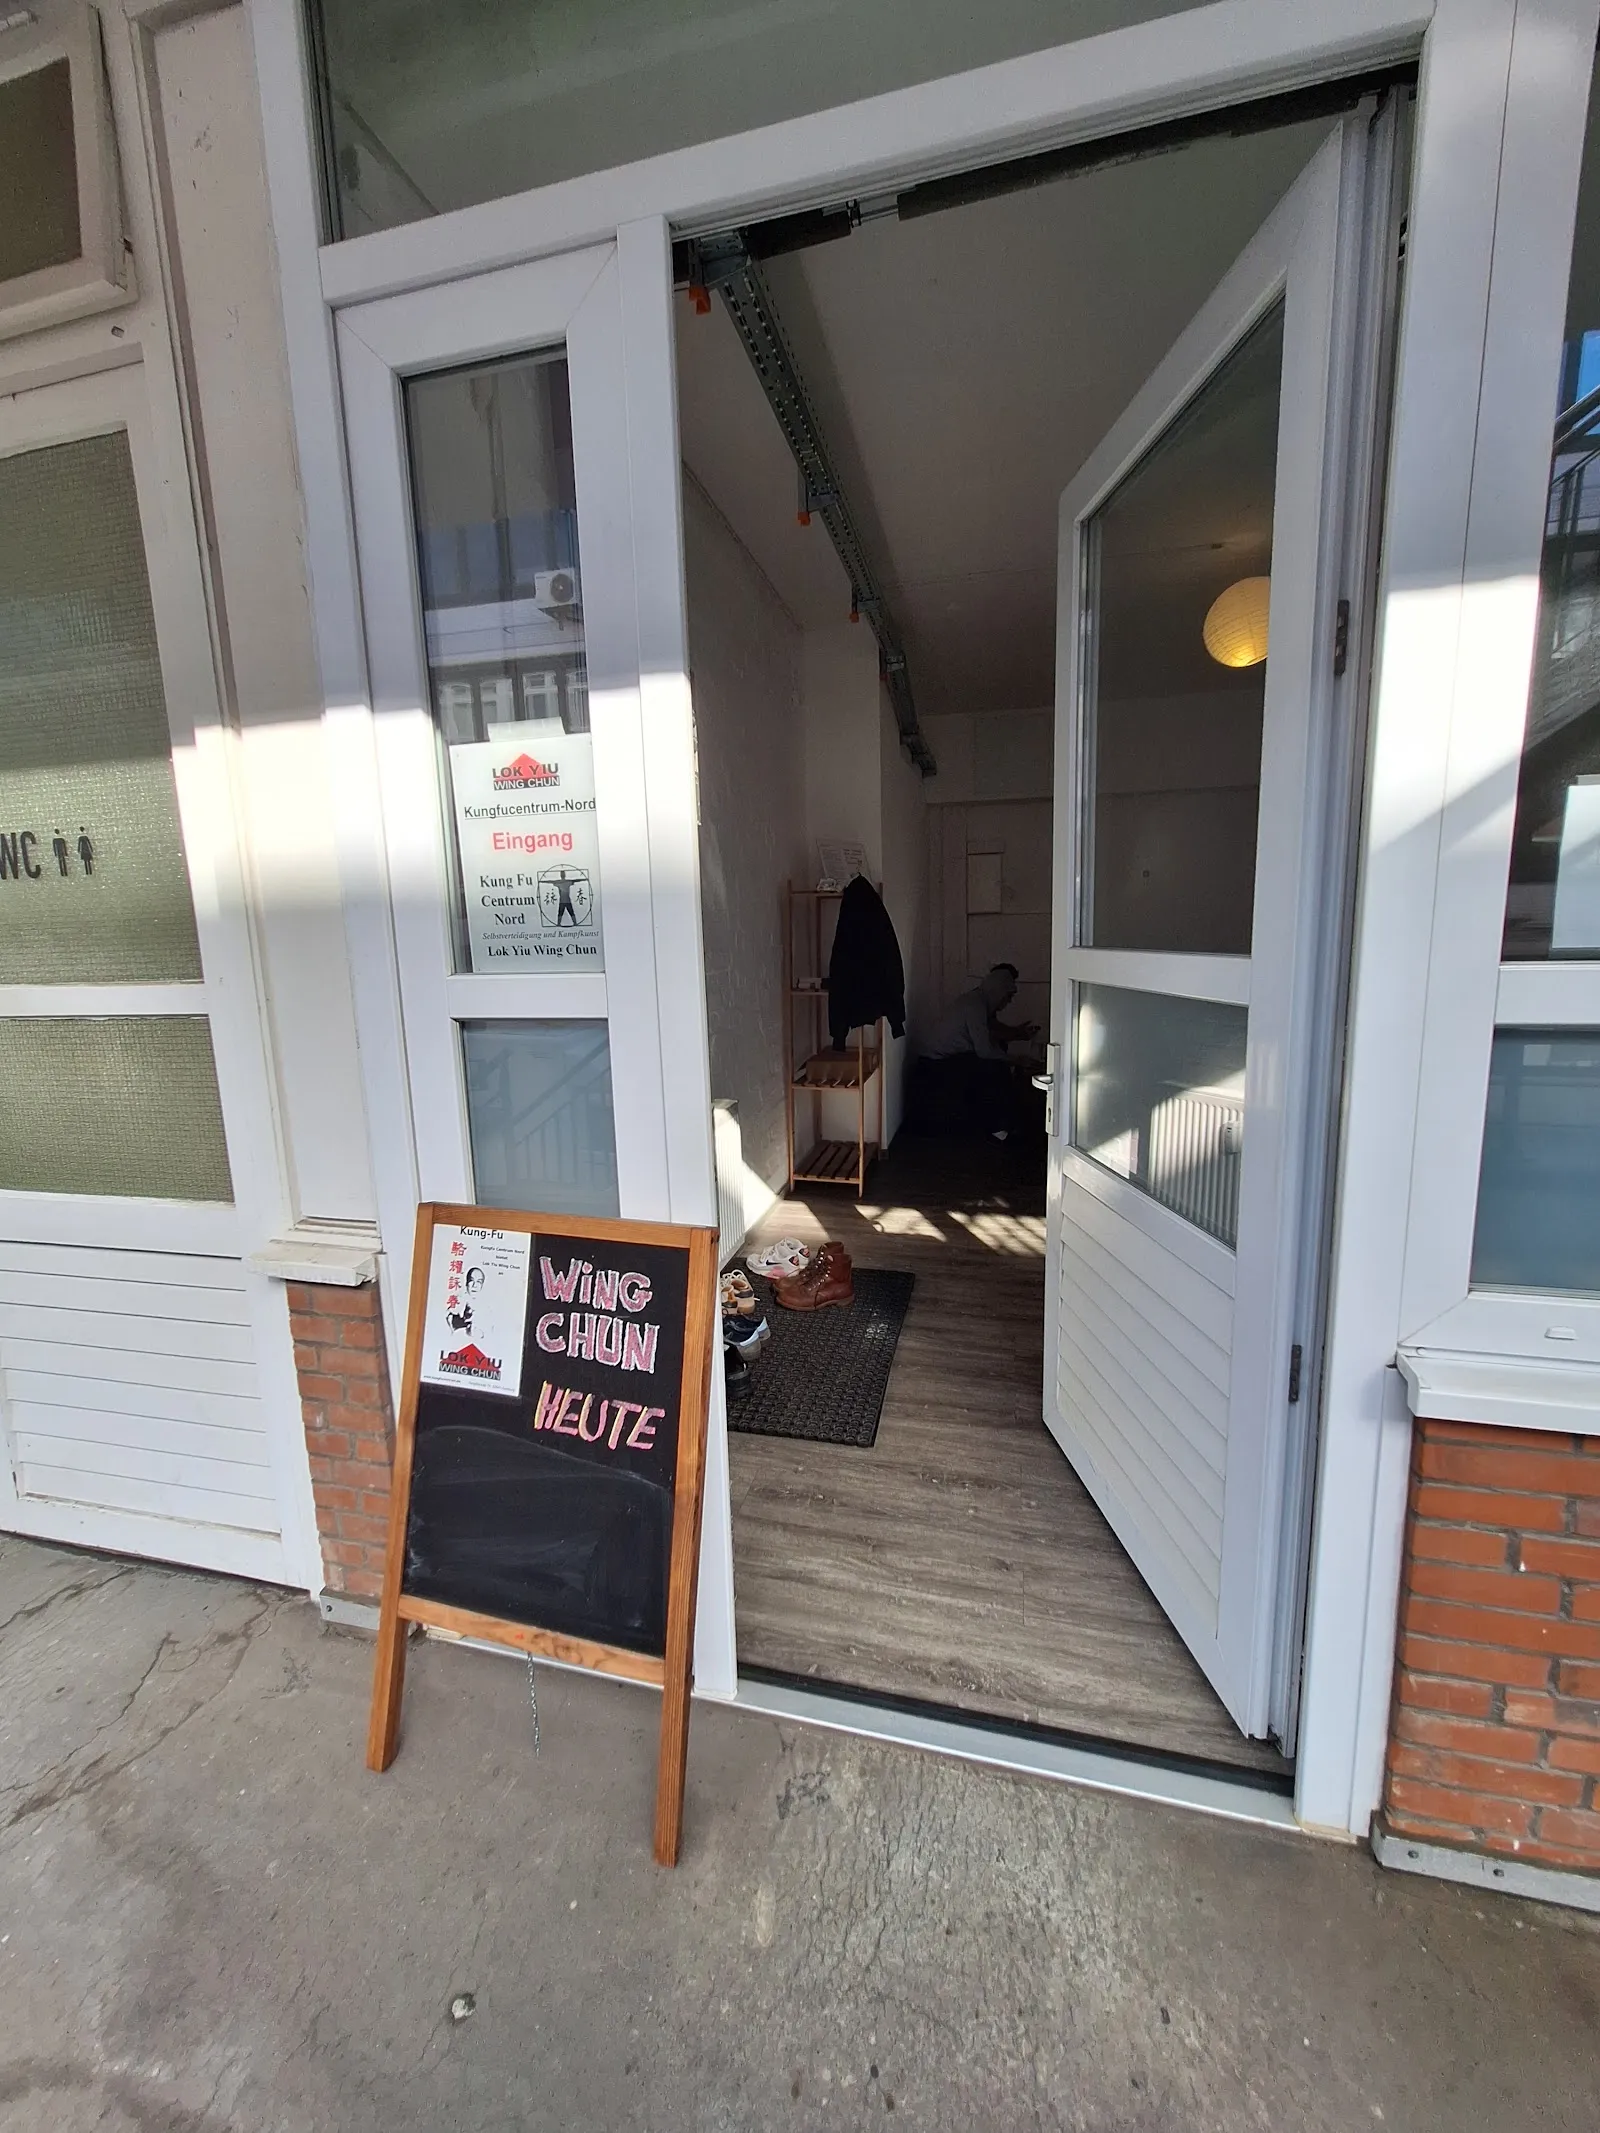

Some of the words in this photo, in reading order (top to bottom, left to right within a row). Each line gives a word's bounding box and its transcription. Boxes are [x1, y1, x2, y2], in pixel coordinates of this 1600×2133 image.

[492, 765, 523, 779] LOK
[529, 762, 560, 776] YIU
[494, 778, 525, 790] WING
[527, 774, 560, 788] CHUN
[464, 797, 596, 819] Kungfucentrum-Nord
[492, 831, 573, 853] Eingang
[0, 831, 41, 880] WC
[480, 875, 513, 890] Kung
[517, 873, 533, 887] Fu
[481, 894, 535, 908] Centrum
[494, 912, 526, 926] Nord
[482, 931, 541, 941] Selbstverteidigung
[543, 931, 556, 939] und
[558, 929, 599, 940] Kampfkunst
[488, 945, 509, 957] Lok
[511, 945, 531, 957] Yiu
[534, 944, 563, 958] Wing
[565, 943, 597, 956] Chun
[460, 1226, 504, 1239] Kung-Fu
[535, 1312, 660, 1374] CHUN
[440, 1350, 469, 1364] LOK
[474, 1355, 502, 1369] YIU
[440, 1363, 468, 1375] WING
[471, 1367, 500, 1380] CHUN
[534, 1380, 666, 1450] HEUTE
